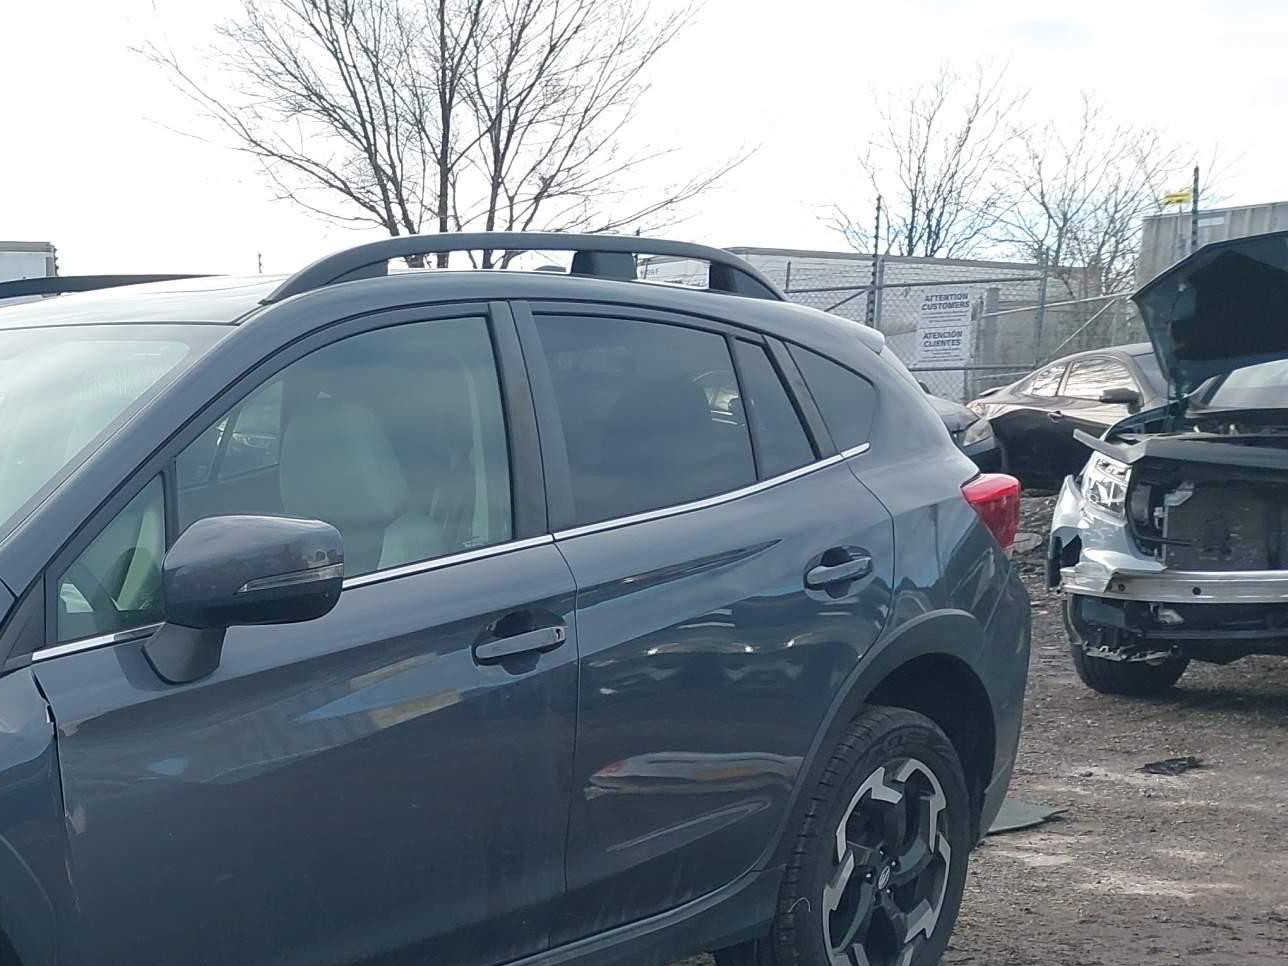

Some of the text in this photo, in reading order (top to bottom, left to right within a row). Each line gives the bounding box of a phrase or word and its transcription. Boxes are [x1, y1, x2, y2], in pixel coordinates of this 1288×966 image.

[924, 293, 969, 302] ATTENTION
[921, 301, 970, 310] CUSTOMERS
[923, 339, 961, 348] CLIENTES
